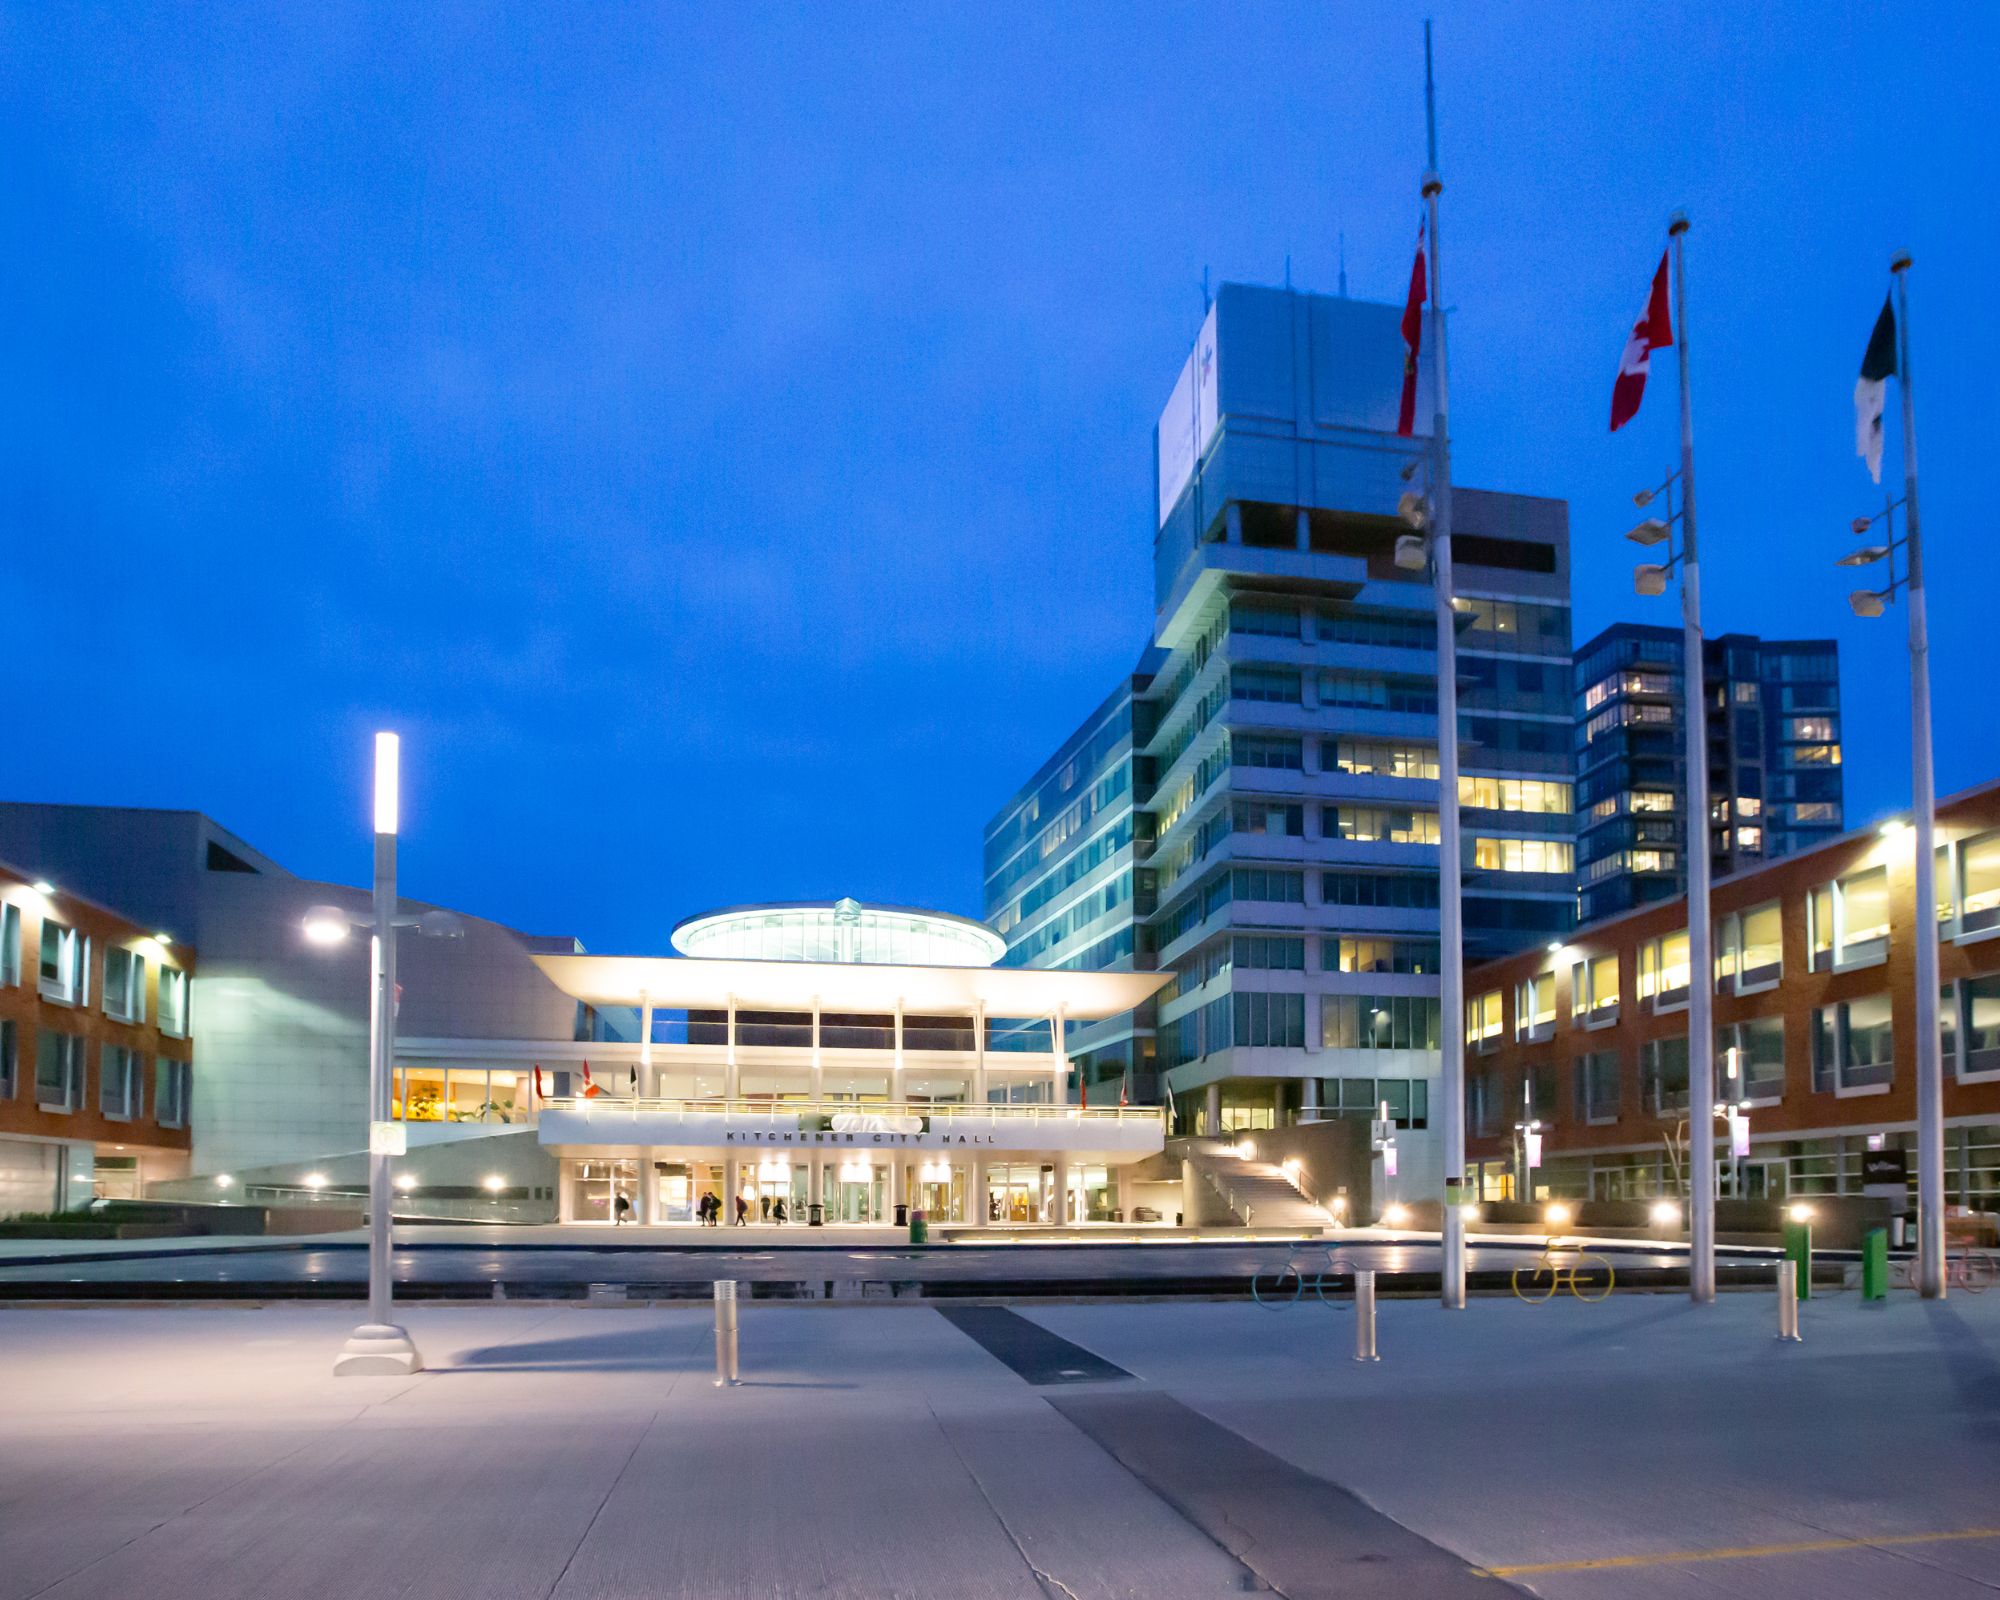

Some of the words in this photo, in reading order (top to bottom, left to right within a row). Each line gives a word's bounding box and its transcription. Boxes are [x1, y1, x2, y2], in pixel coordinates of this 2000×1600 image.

[726, 1132, 854, 1142] KITCHENER
[873, 1134, 923, 1143] CITY
[942, 1135, 994, 1144] HALL
